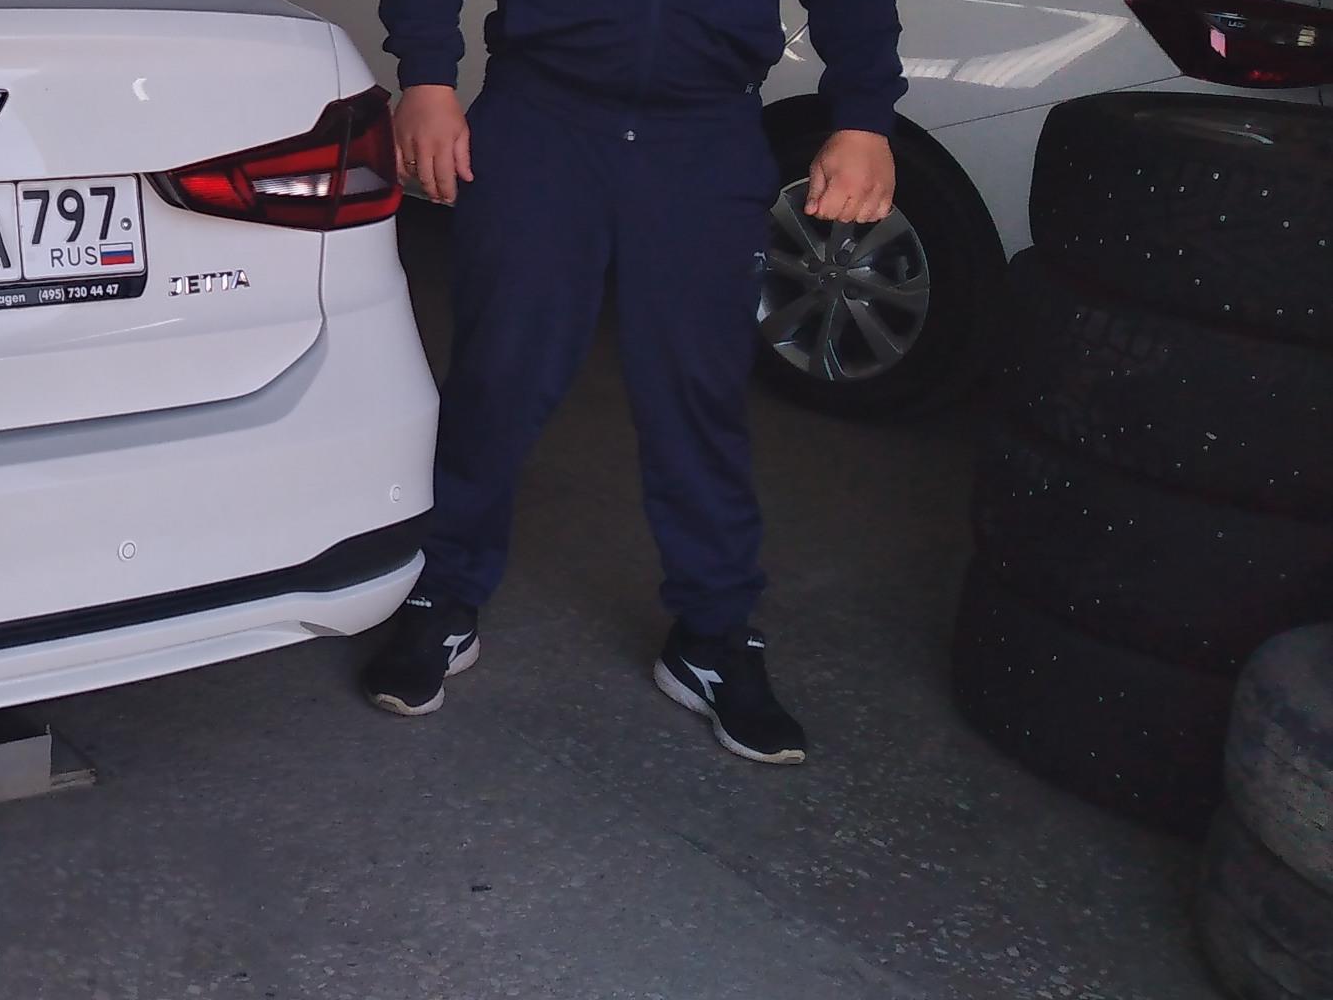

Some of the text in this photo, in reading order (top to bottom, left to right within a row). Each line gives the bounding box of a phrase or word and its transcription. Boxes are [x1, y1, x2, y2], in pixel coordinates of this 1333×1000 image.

[22, 186, 116, 245] 797
[51, 246, 98, 269] RUS
[38, 288, 65, 303] (495)
[68, 286, 87, 298] 730
[90, 285, 103, 296] 44
[105, 284, 119, 295] 47
[169, 269, 250, 296] JETTA
